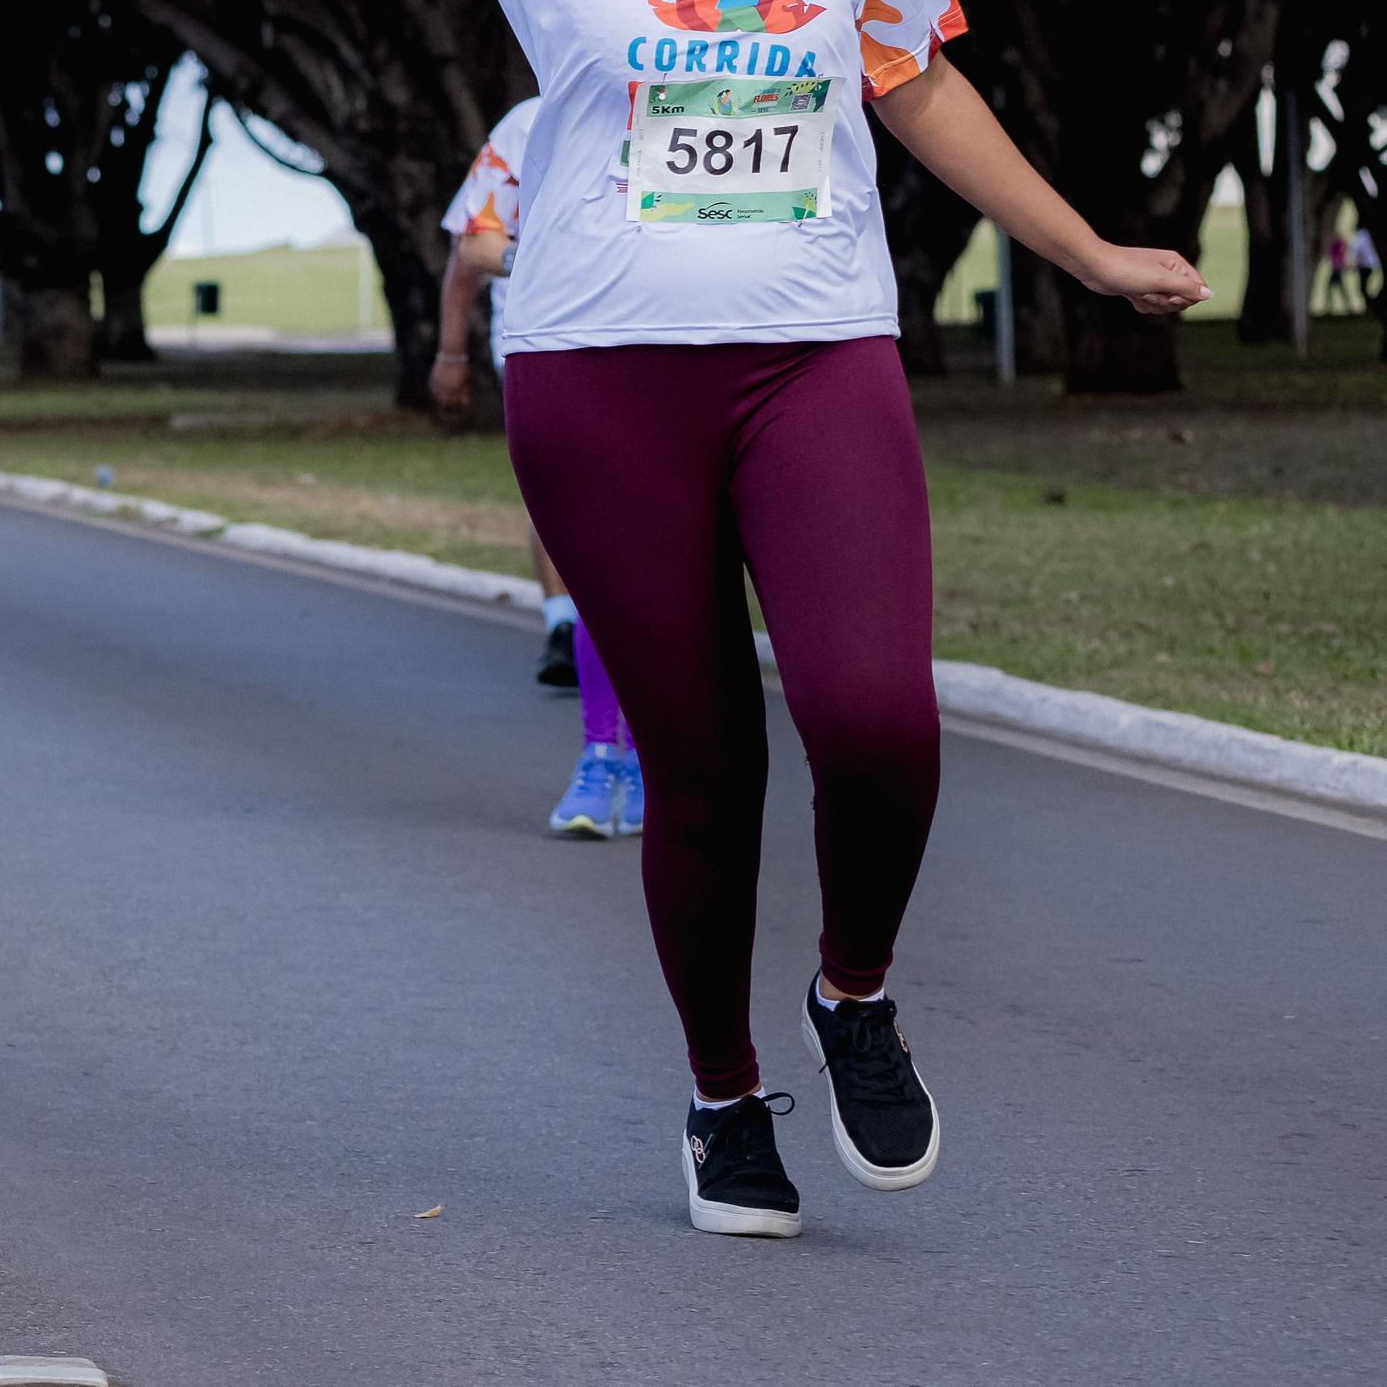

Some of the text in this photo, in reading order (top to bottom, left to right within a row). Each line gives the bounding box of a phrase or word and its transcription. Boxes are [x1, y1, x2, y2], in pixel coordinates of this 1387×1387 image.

[628, 36, 818, 77] CORRIDA
[753, 93, 780, 103] FLORES
[651, 105, 684, 115] 5Km
[665, 124, 799, 176] 5817
[697, 208, 733, 219] Sesc
